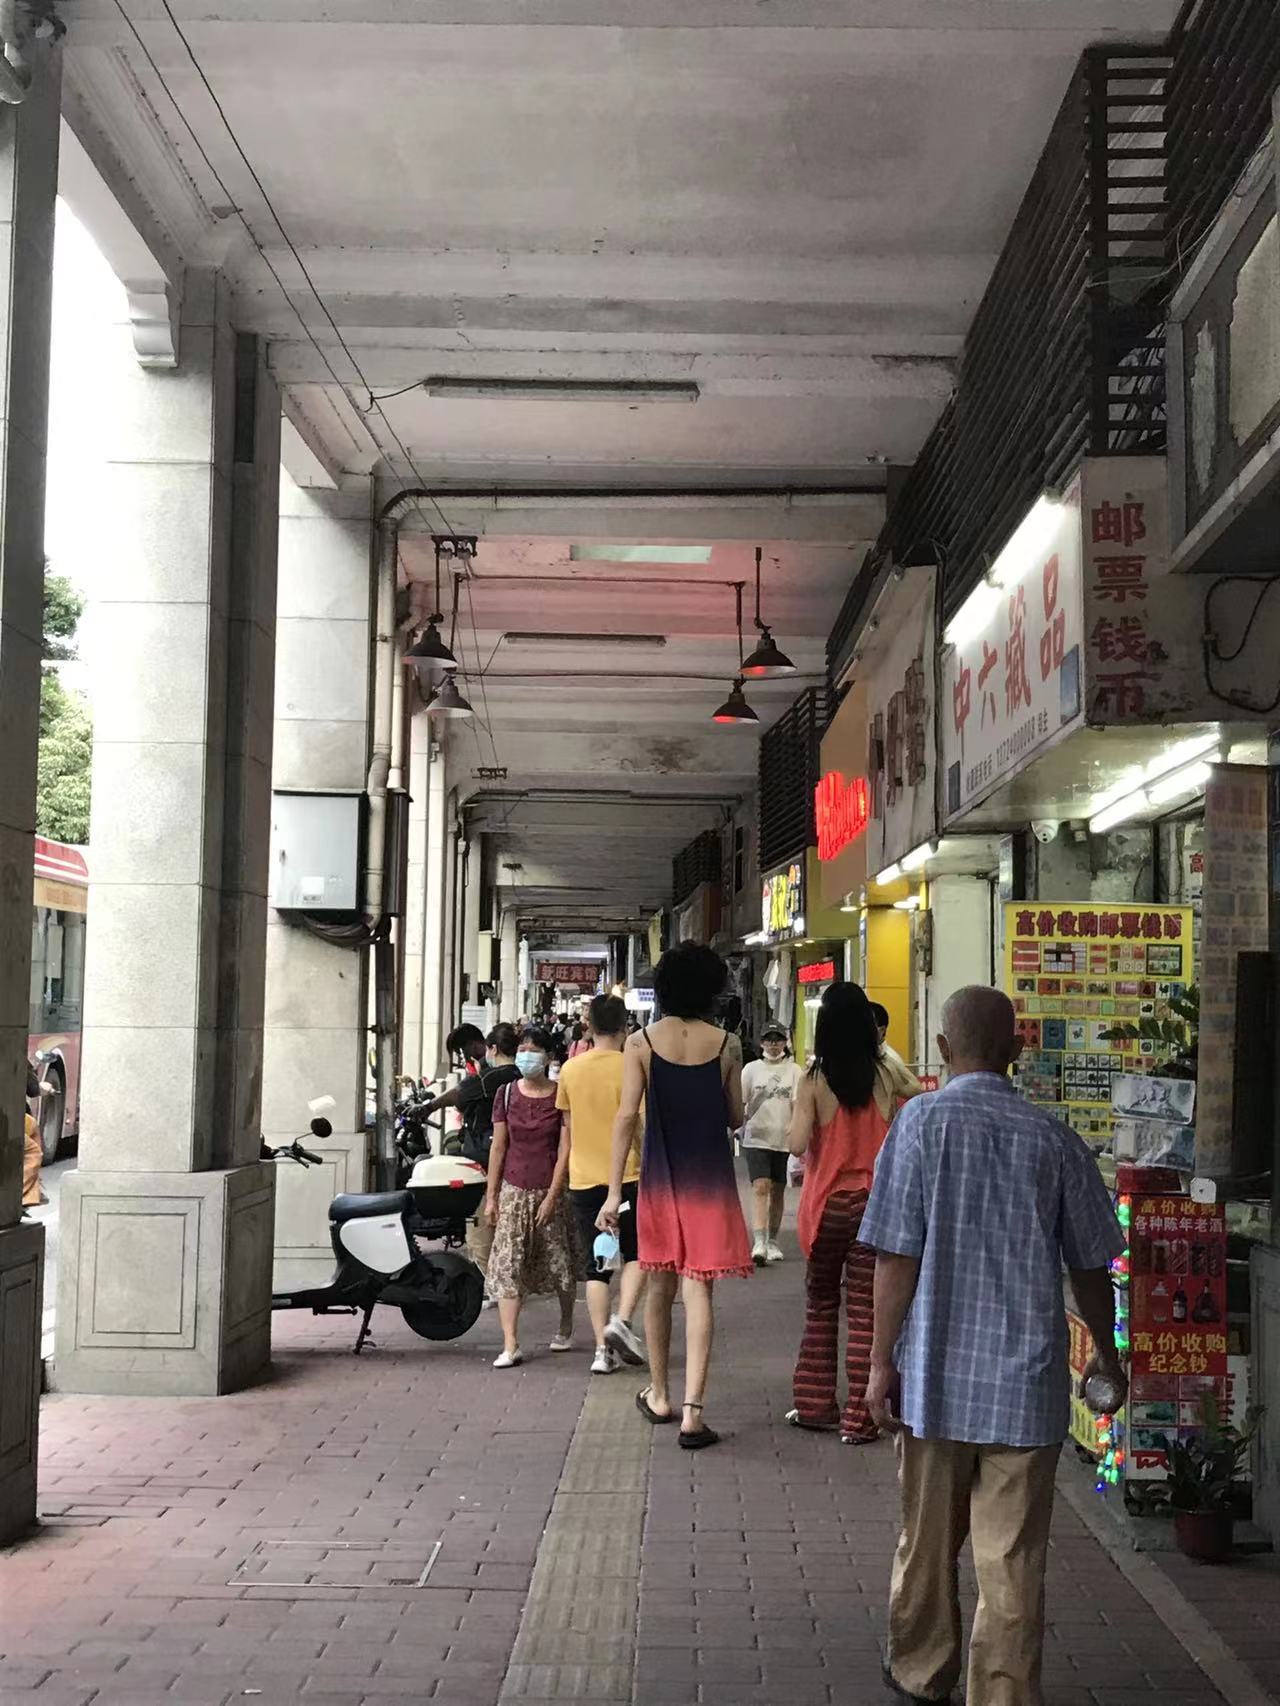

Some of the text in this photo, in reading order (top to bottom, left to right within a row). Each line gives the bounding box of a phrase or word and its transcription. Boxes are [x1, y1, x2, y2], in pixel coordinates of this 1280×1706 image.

[953, 552, 1065, 766] 中六藏品
[1016, 910, 1183, 939] 高价收购邮票钱币
[1141, 1200, 1217, 1216] 高价收购
[1134, 1215, 1223, 1233] 各种陈年老酒
[1132, 1332, 1227, 1353] 高价收购
[1149, 1353, 1208, 1373] 纪念钞
